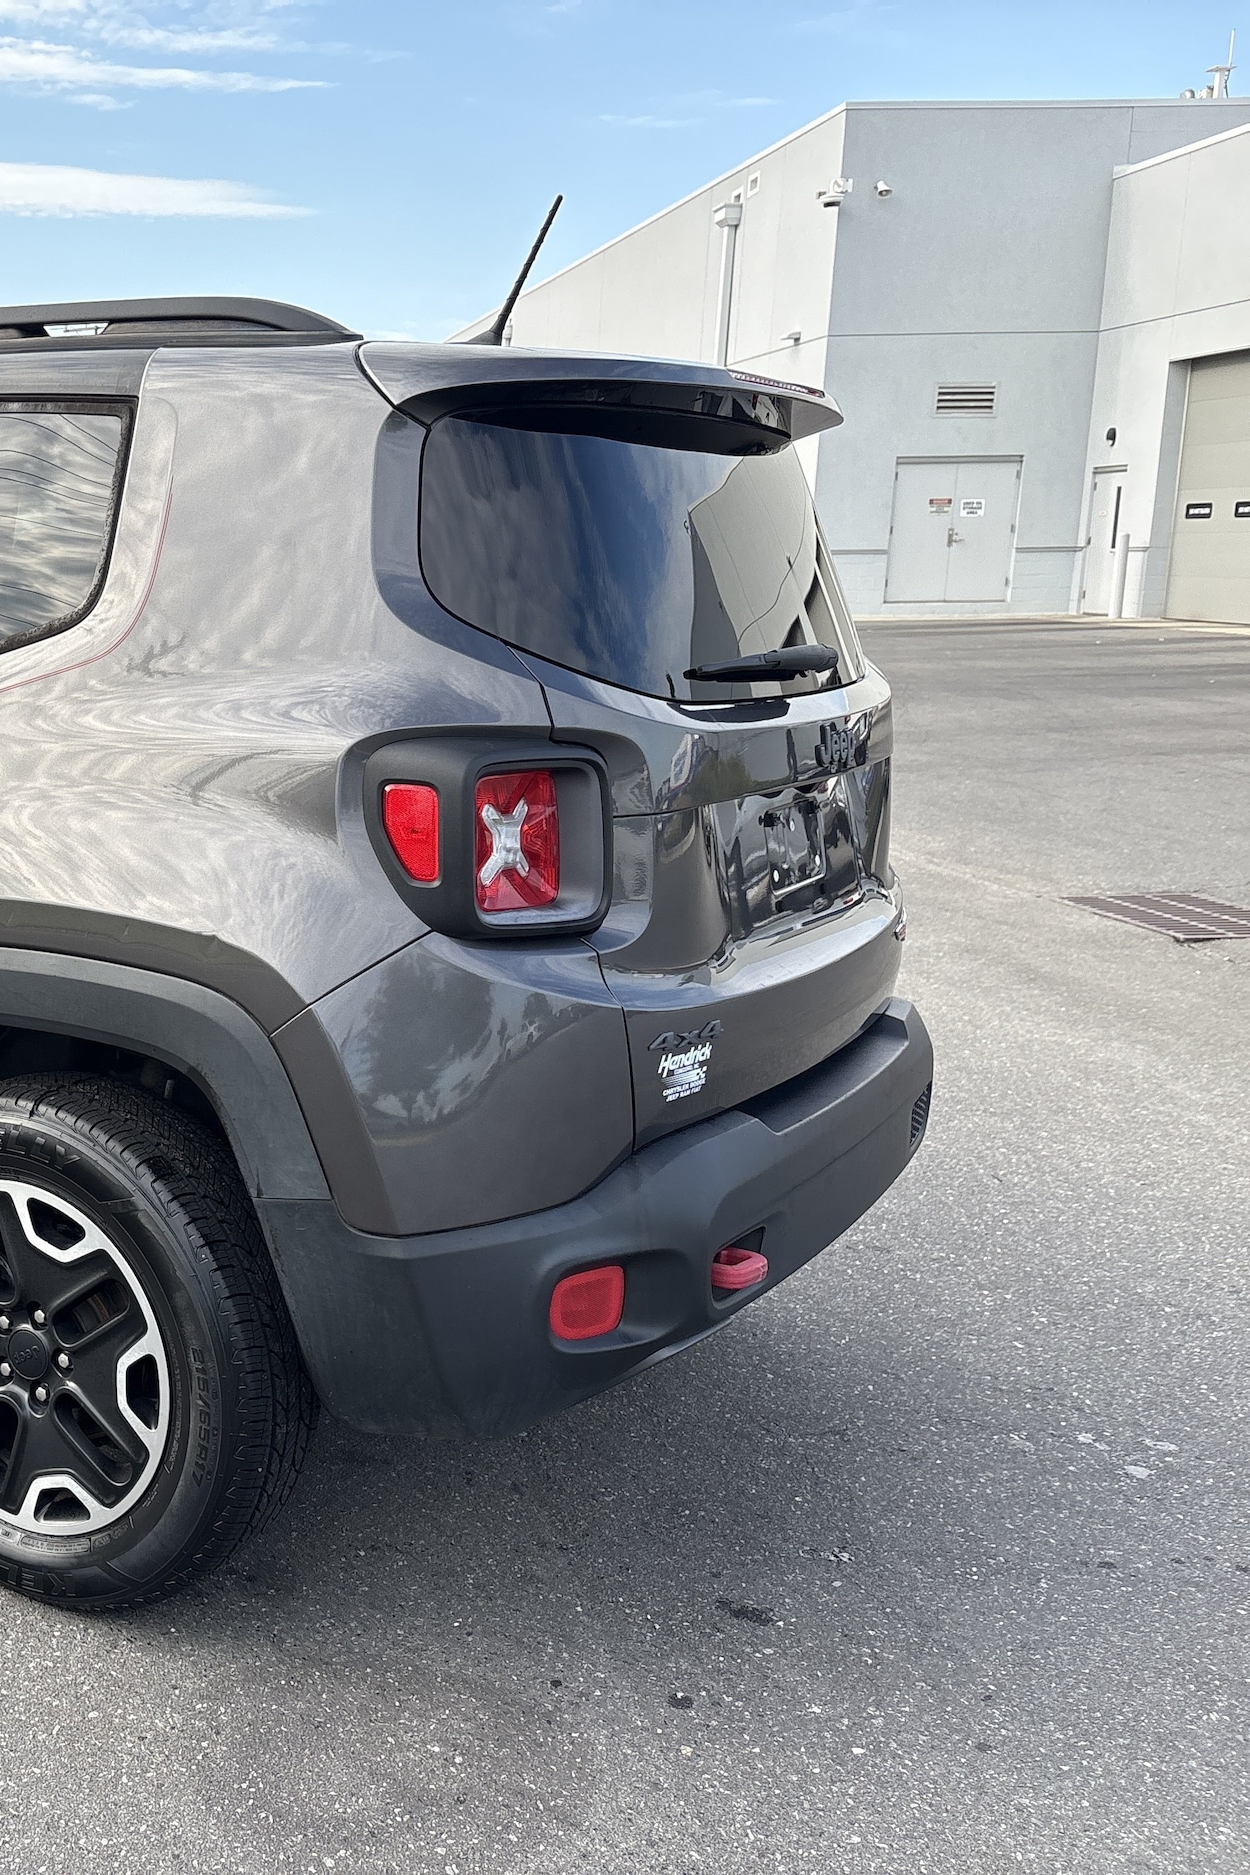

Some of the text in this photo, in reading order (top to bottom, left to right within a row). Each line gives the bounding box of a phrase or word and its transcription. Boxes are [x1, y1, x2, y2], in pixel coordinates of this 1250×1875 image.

[815, 722, 858, 769] Jeep
[648, 1020, 723, 1051] 4x4
[657, 1042, 713, 1078] Hendrick
[662, 1078, 707, 1097] CHRYSLER DODGE
[666, 1086, 702, 1102] JEEP RAM FIAT
[189, 1346, 211, 1488] 215/65R17
